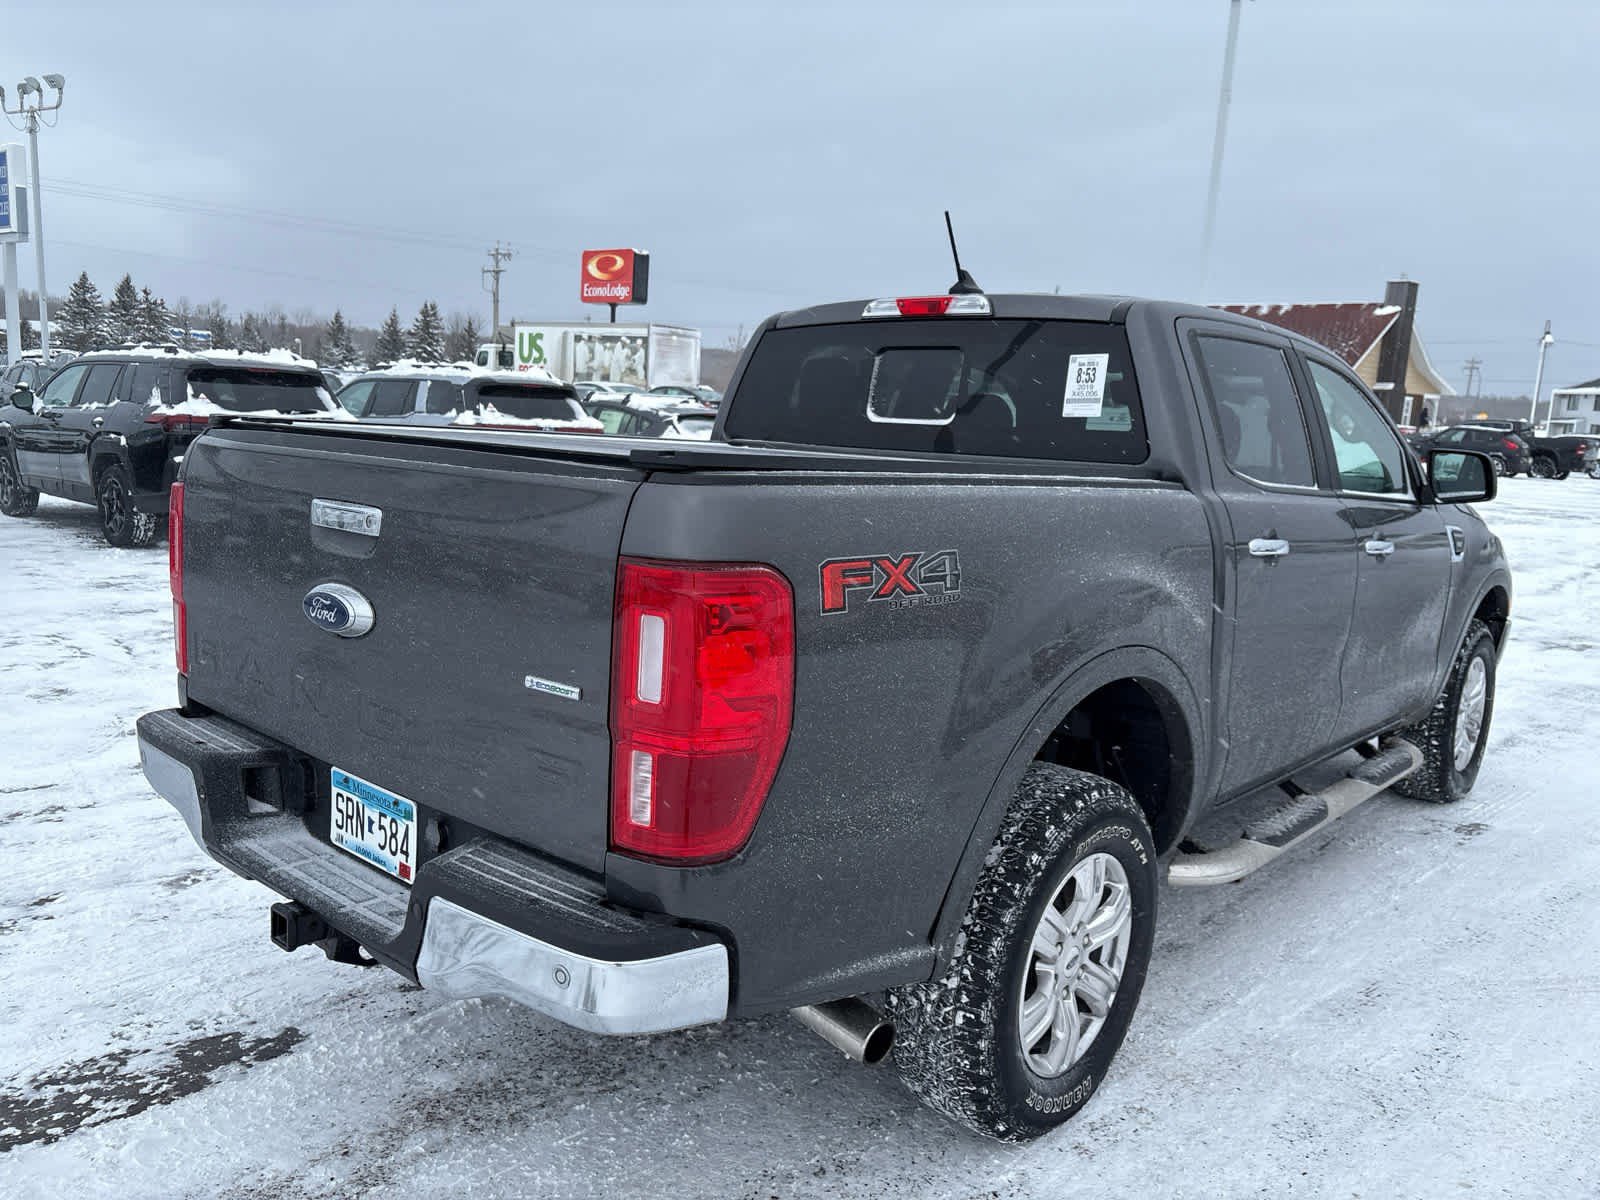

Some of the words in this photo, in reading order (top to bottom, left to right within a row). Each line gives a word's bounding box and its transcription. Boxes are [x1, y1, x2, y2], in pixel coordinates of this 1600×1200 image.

[1076, 367, 1097, 384] 8:53
[818, 549, 961, 616] FX4
[309, 596, 338, 623] Ford
[889, 599, 920, 611] OFF
[352, 782, 392, 809] Minnesota
[335, 792, 366, 841] SRN
[378, 811, 410, 863] 584
